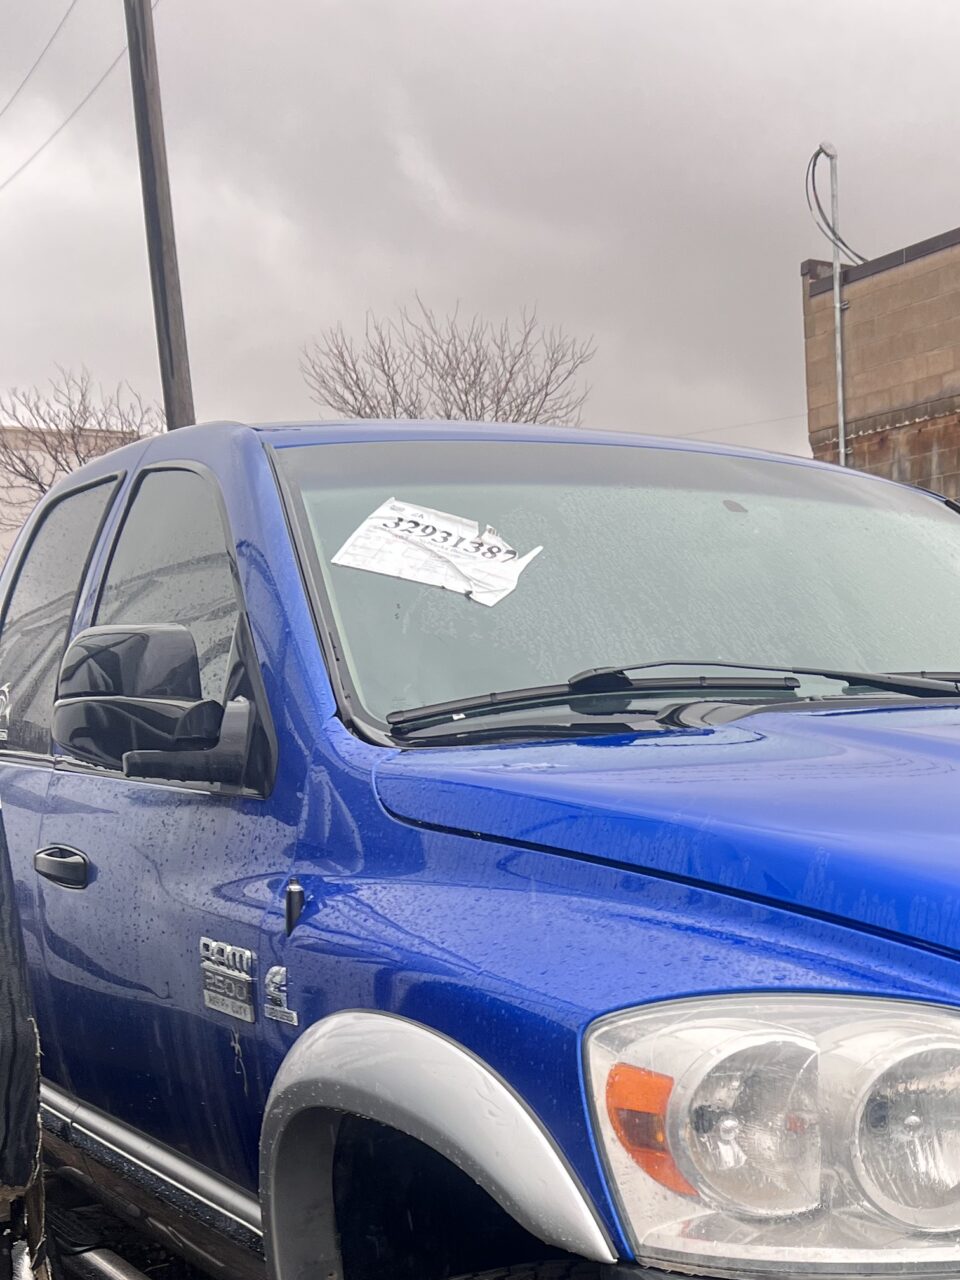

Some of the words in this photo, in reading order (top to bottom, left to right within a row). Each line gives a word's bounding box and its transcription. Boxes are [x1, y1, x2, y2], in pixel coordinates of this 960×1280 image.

[382, 517, 518, 563] 32931387
[200, 936, 252, 972] RAM
[204, 971, 247, 1000] 2500
